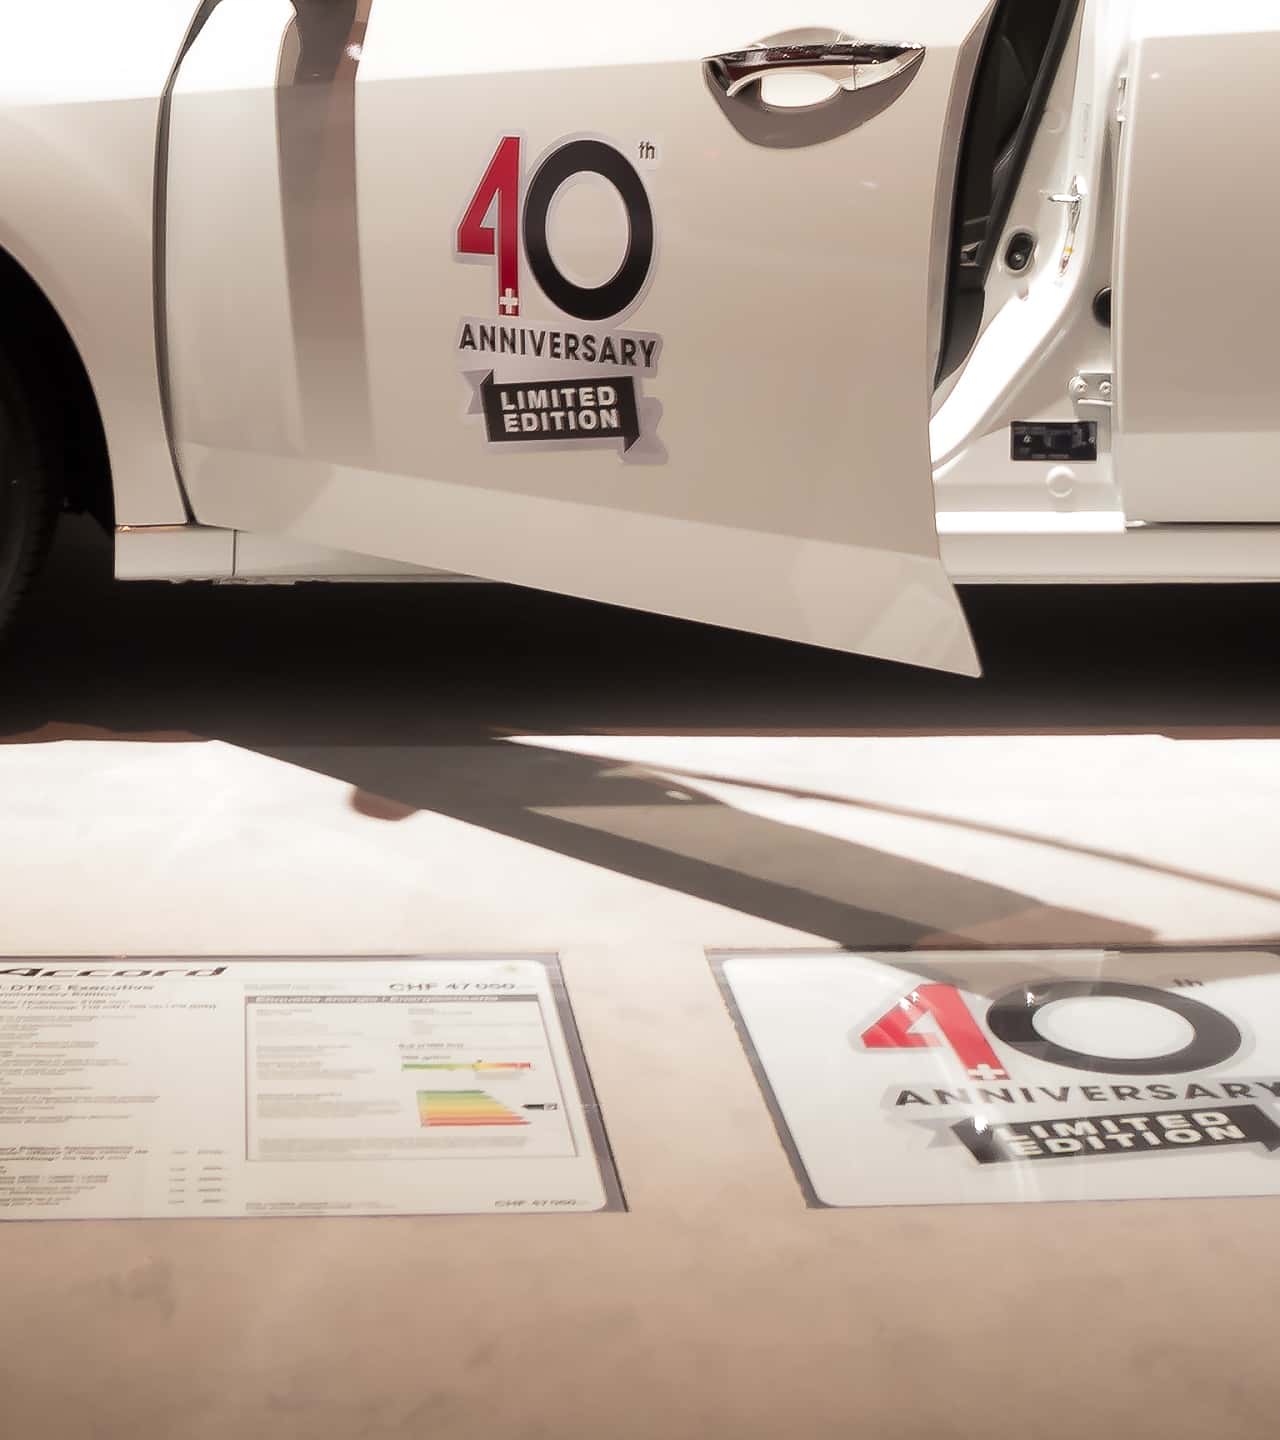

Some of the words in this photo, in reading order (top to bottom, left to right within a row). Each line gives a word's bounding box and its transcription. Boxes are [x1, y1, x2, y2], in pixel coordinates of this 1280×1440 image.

[459, 322, 659, 368] ANNIVERSARY
[500, 385, 618, 411] LIMITED
[503, 408, 621, 434] EDITION
[999, 1110, 1234, 1142] LIMITED
[1011, 1123, 1246, 1157] EDITION
